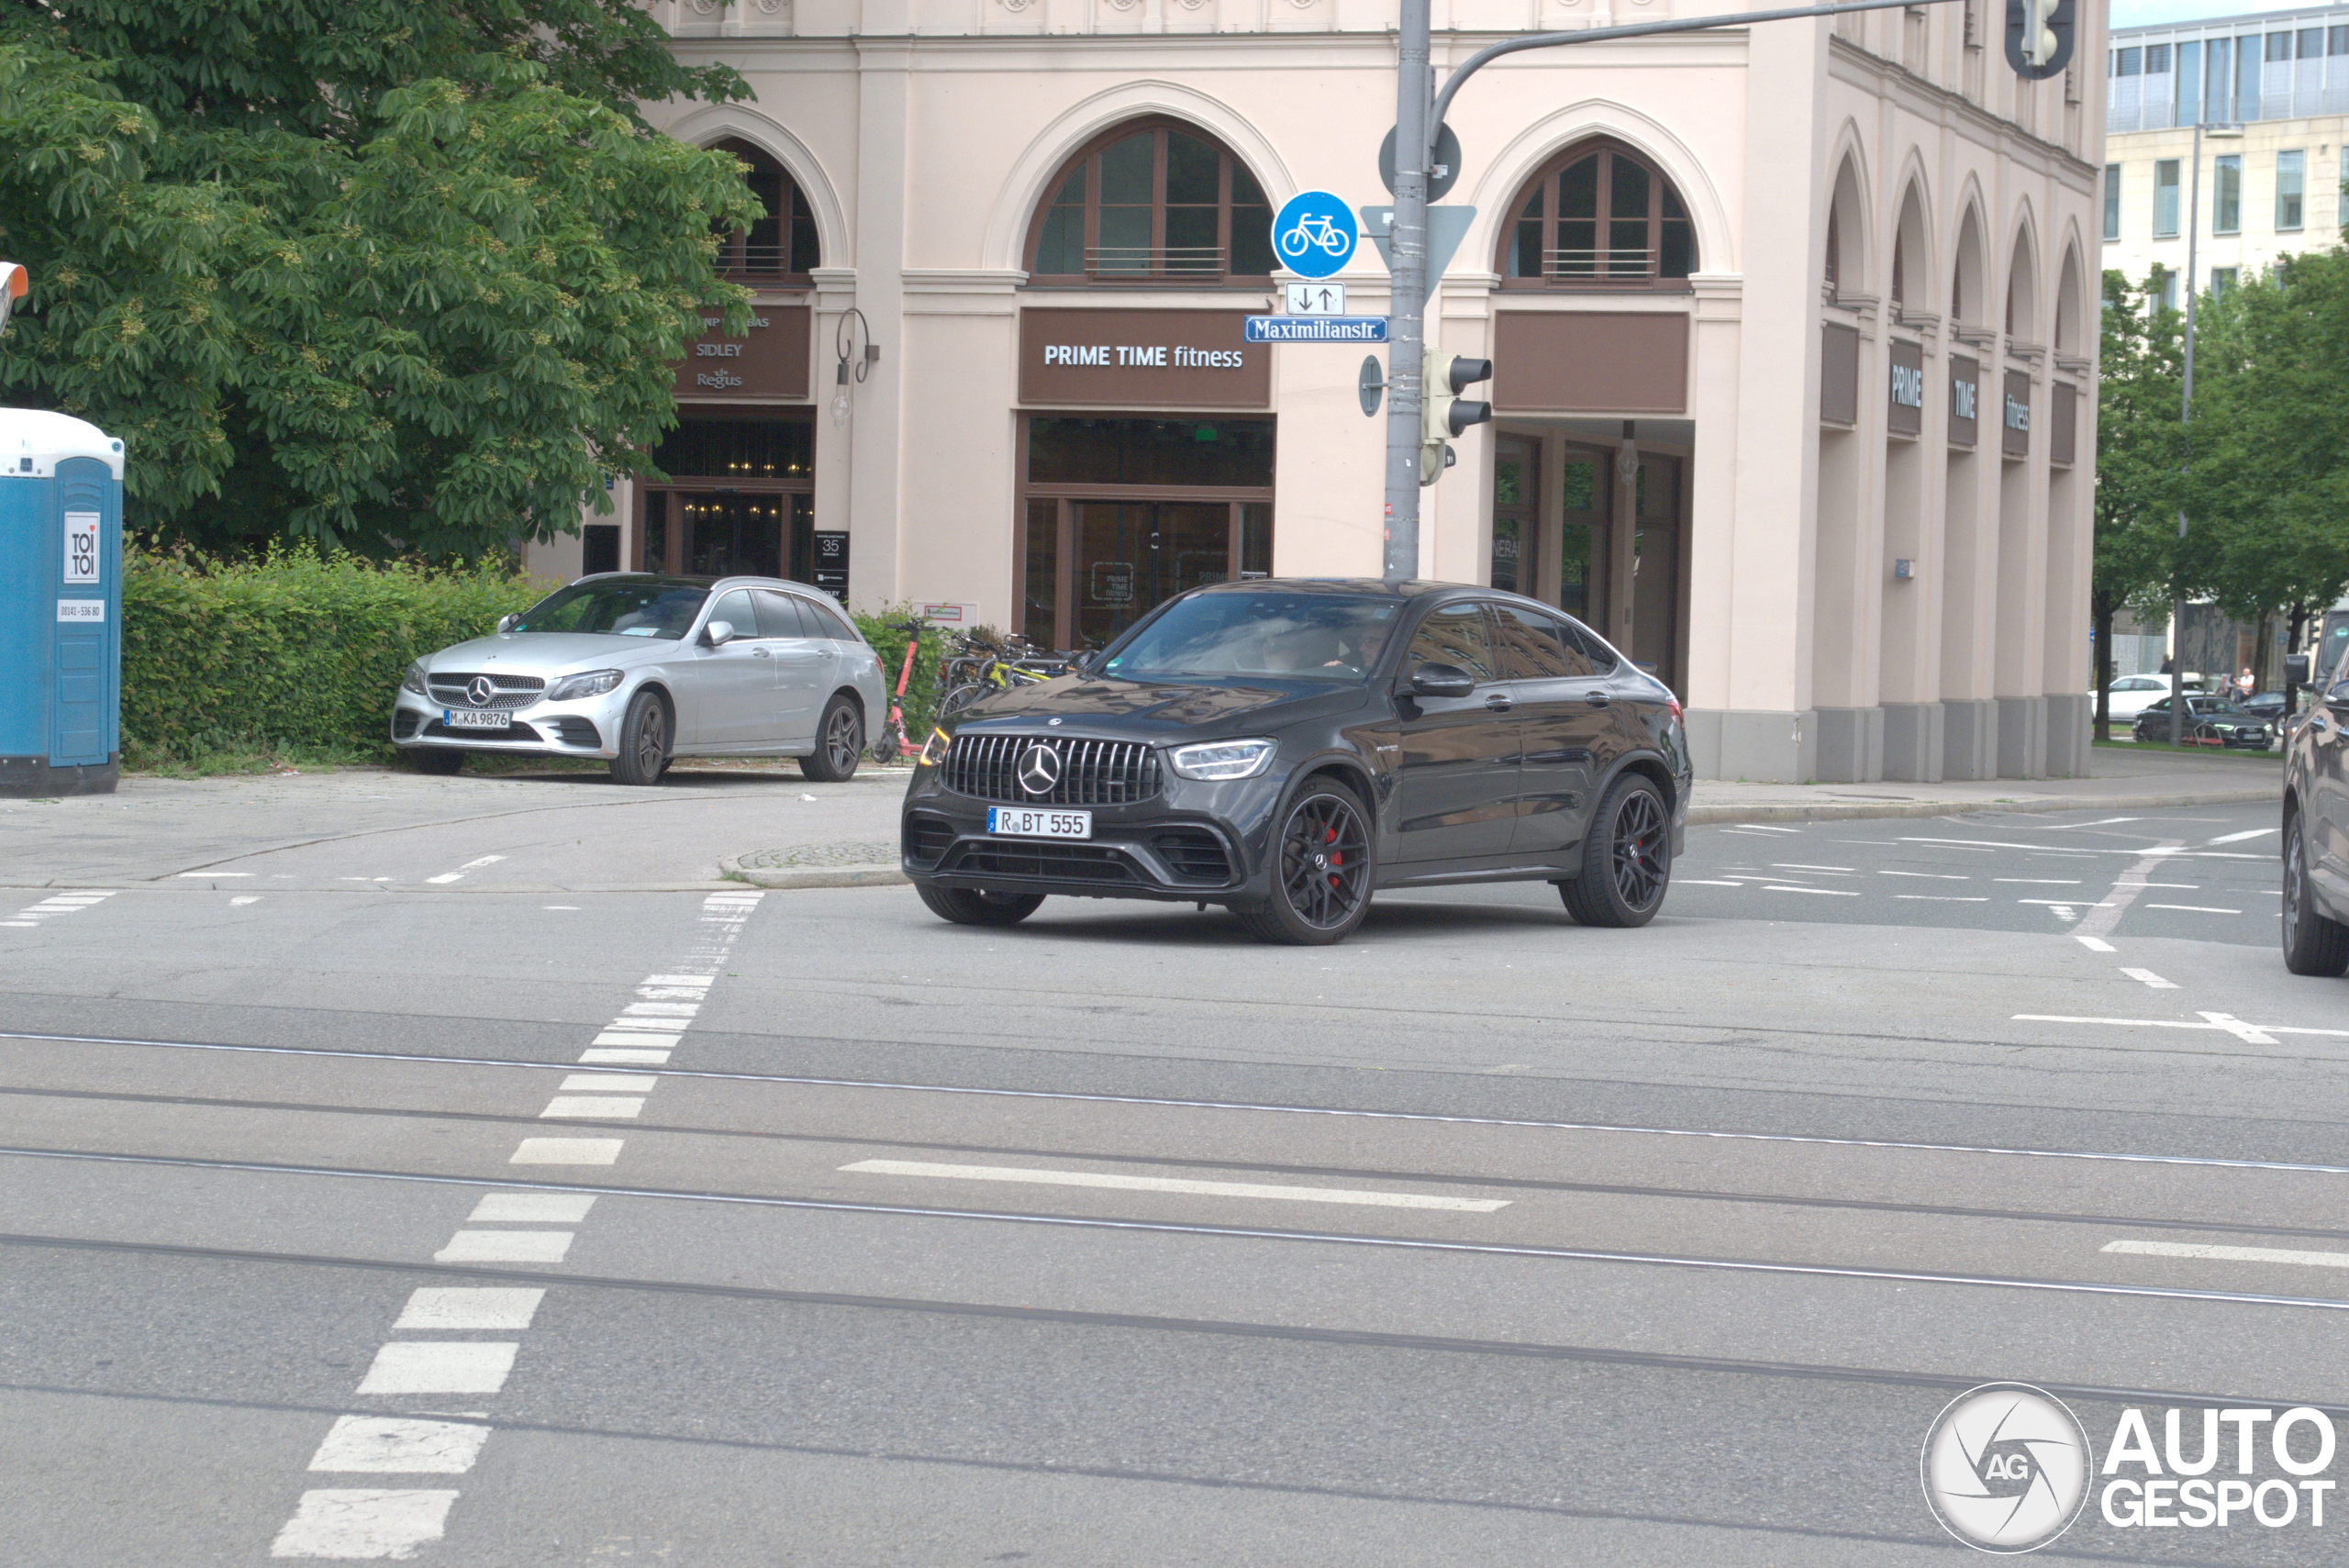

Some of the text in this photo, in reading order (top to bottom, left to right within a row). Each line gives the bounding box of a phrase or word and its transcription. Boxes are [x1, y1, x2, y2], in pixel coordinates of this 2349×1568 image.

[1254, 320, 1378, 339] Maximilianstr.
[696, 344, 743, 357] SIDLEY
[1045, 345, 1242, 367] PRIME TIME fitness
[697, 373, 742, 389] Regus
[1892, 364, 1921, 407] PRIME
[1955, 380, 1975, 419] TIME
[2006, 394, 2028, 431] fitness
[72, 533, 94, 553] TOI
[823, 539, 839, 551] 35
[72, 555, 94, 574] TOI
[451, 712, 507, 725] M KA 9876
[1002, 812, 1011, 830] R
[1022, 813, 1044, 832] BT
[1051, 815, 1084, 834] 555
